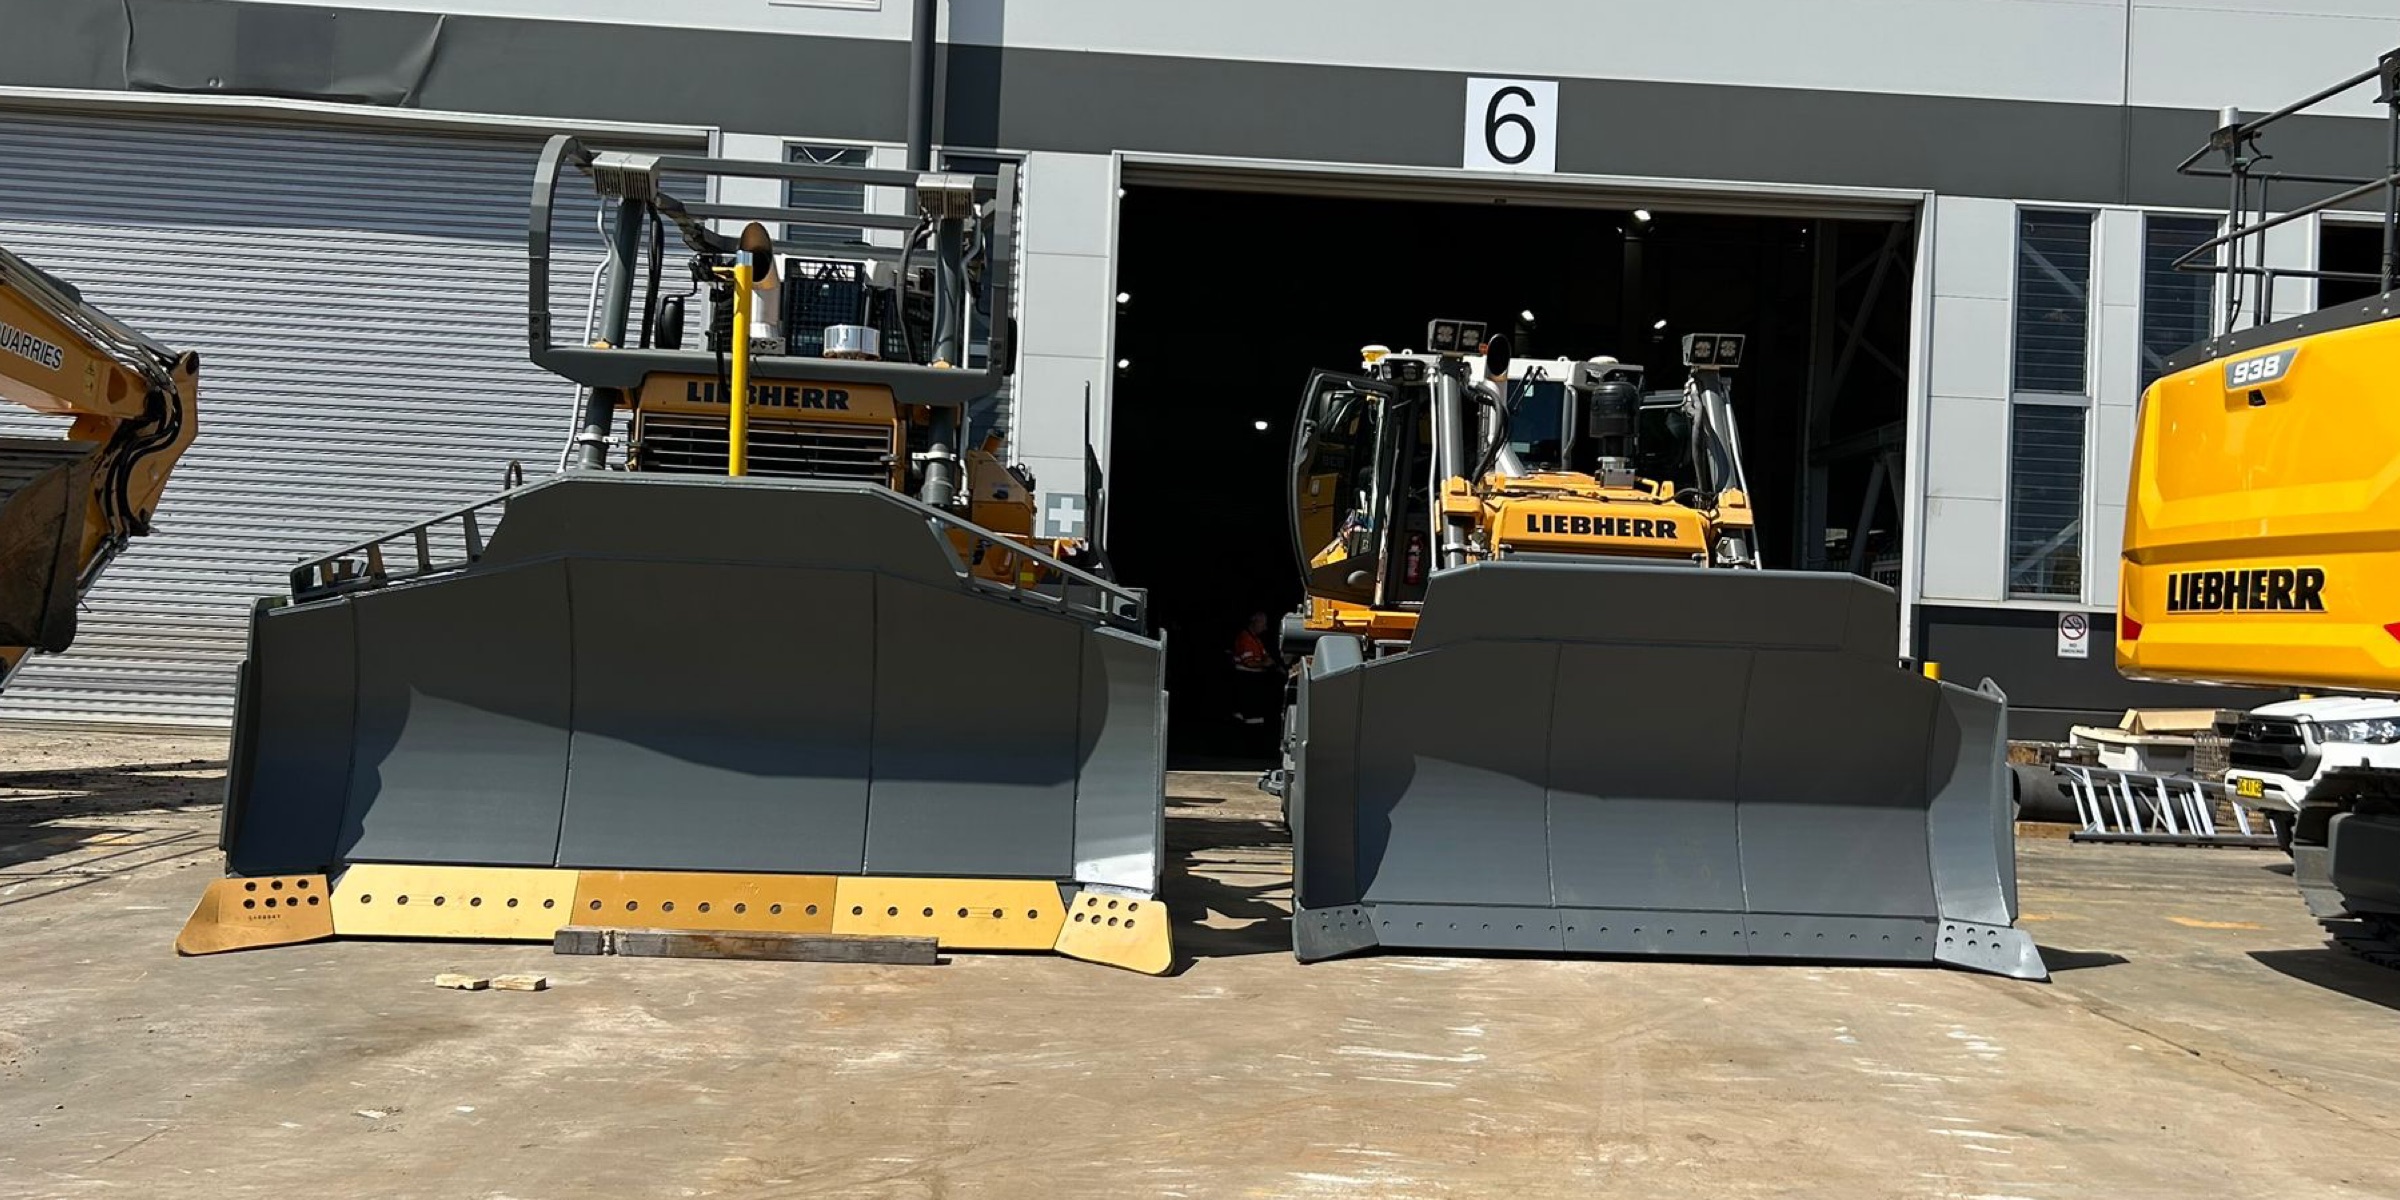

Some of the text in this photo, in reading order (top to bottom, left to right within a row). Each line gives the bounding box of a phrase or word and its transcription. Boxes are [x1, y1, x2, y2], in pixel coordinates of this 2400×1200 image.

[1485, 86, 1535, 164] 6
[0, 322, 63, 370] UARRIES
[2233, 355, 2280, 384] 938
[1527, 513, 1678, 539] LIEBHERR
[2167, 568, 2325, 612] LIEBHERR
